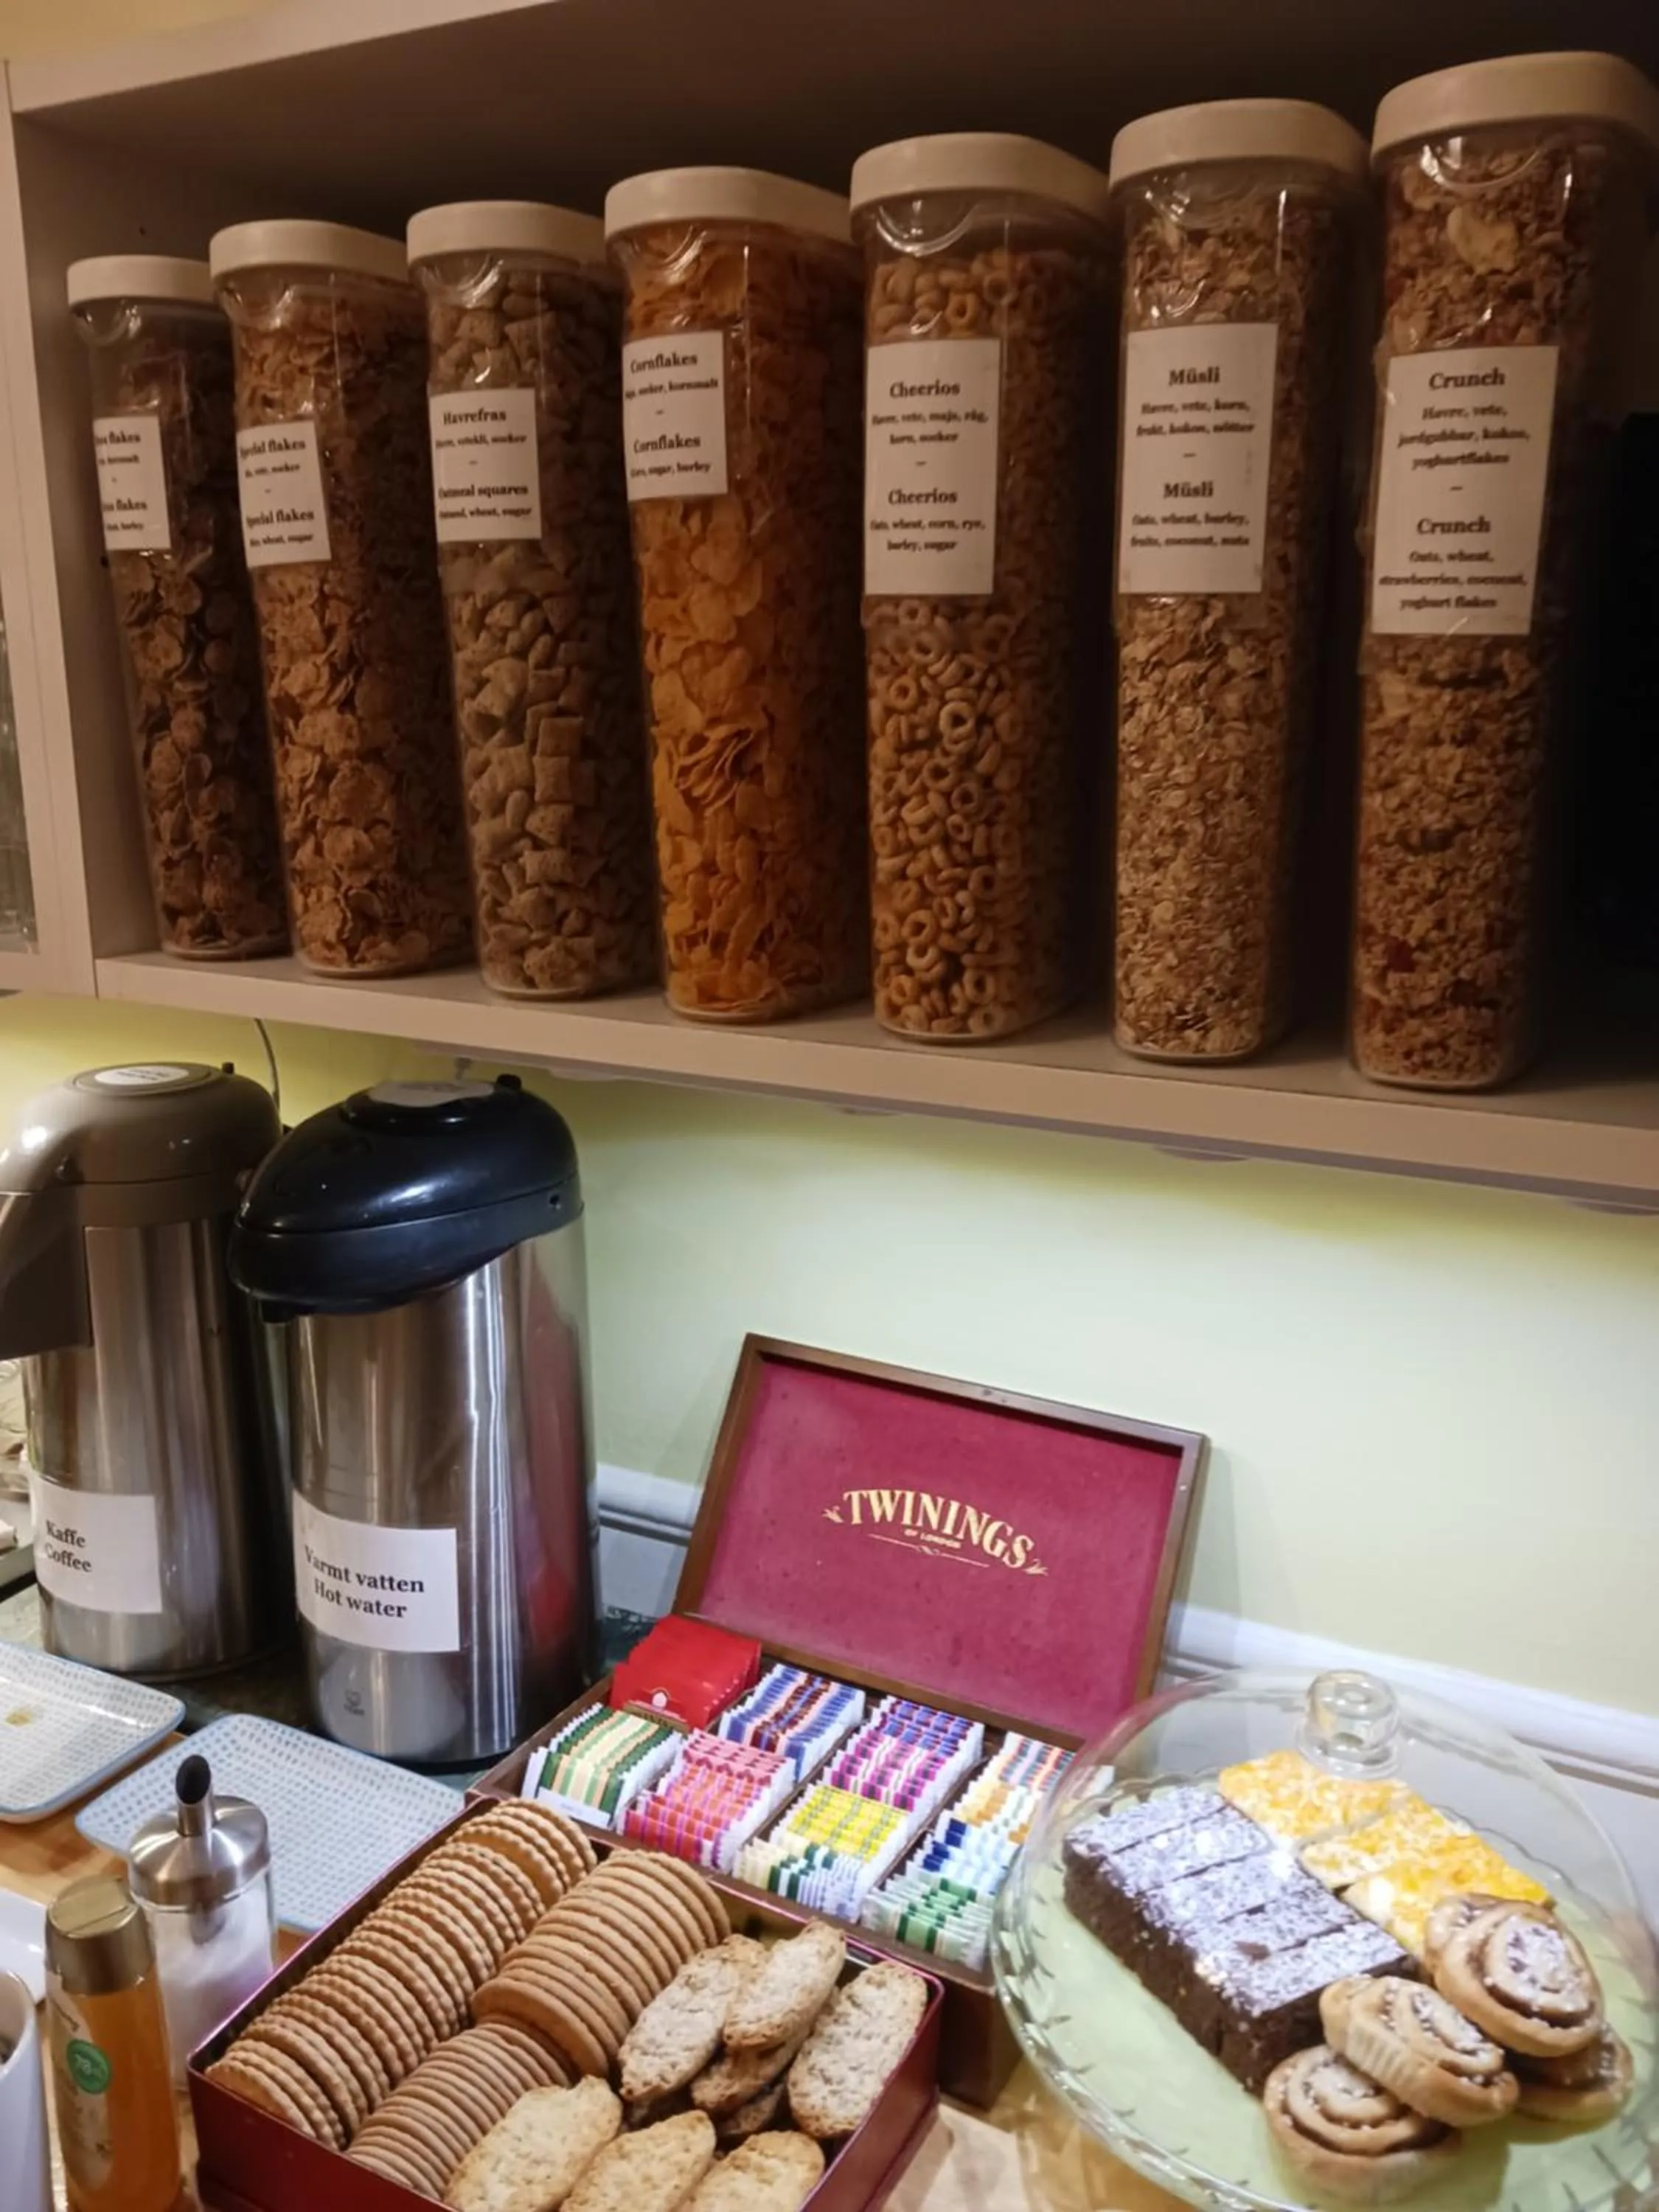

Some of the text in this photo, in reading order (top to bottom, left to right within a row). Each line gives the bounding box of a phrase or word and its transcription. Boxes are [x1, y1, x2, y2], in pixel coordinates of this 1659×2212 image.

[630, 351, 698, 374] Cornflakes
[1168, 366, 1221, 387] Müsli
[1428, 367, 1506, 391] Crunch
[889, 378, 961, 399] Cheerios
[443, 407, 507, 425] Havrefras
[268, 438, 306, 453] flakes
[633, 432, 702, 454] Cornflakes
[477, 484, 529, 499] squares
[888, 487, 959, 506] Cheerios
[1163, 480, 1214, 499] Müsli
[246, 508, 315, 529] pecial flakes
[1416, 515, 1492, 535] Crunch
[1446, 549, 1495, 563] wheat,
[45, 1520, 87, 1549] Kaffe
[843, 1489, 1034, 1569] TWININGS
[44, 1542, 93, 1573] Coffee
[304, 1544, 425, 1594] Varmt vatten
[313, 1577, 408, 1619] Hot water
